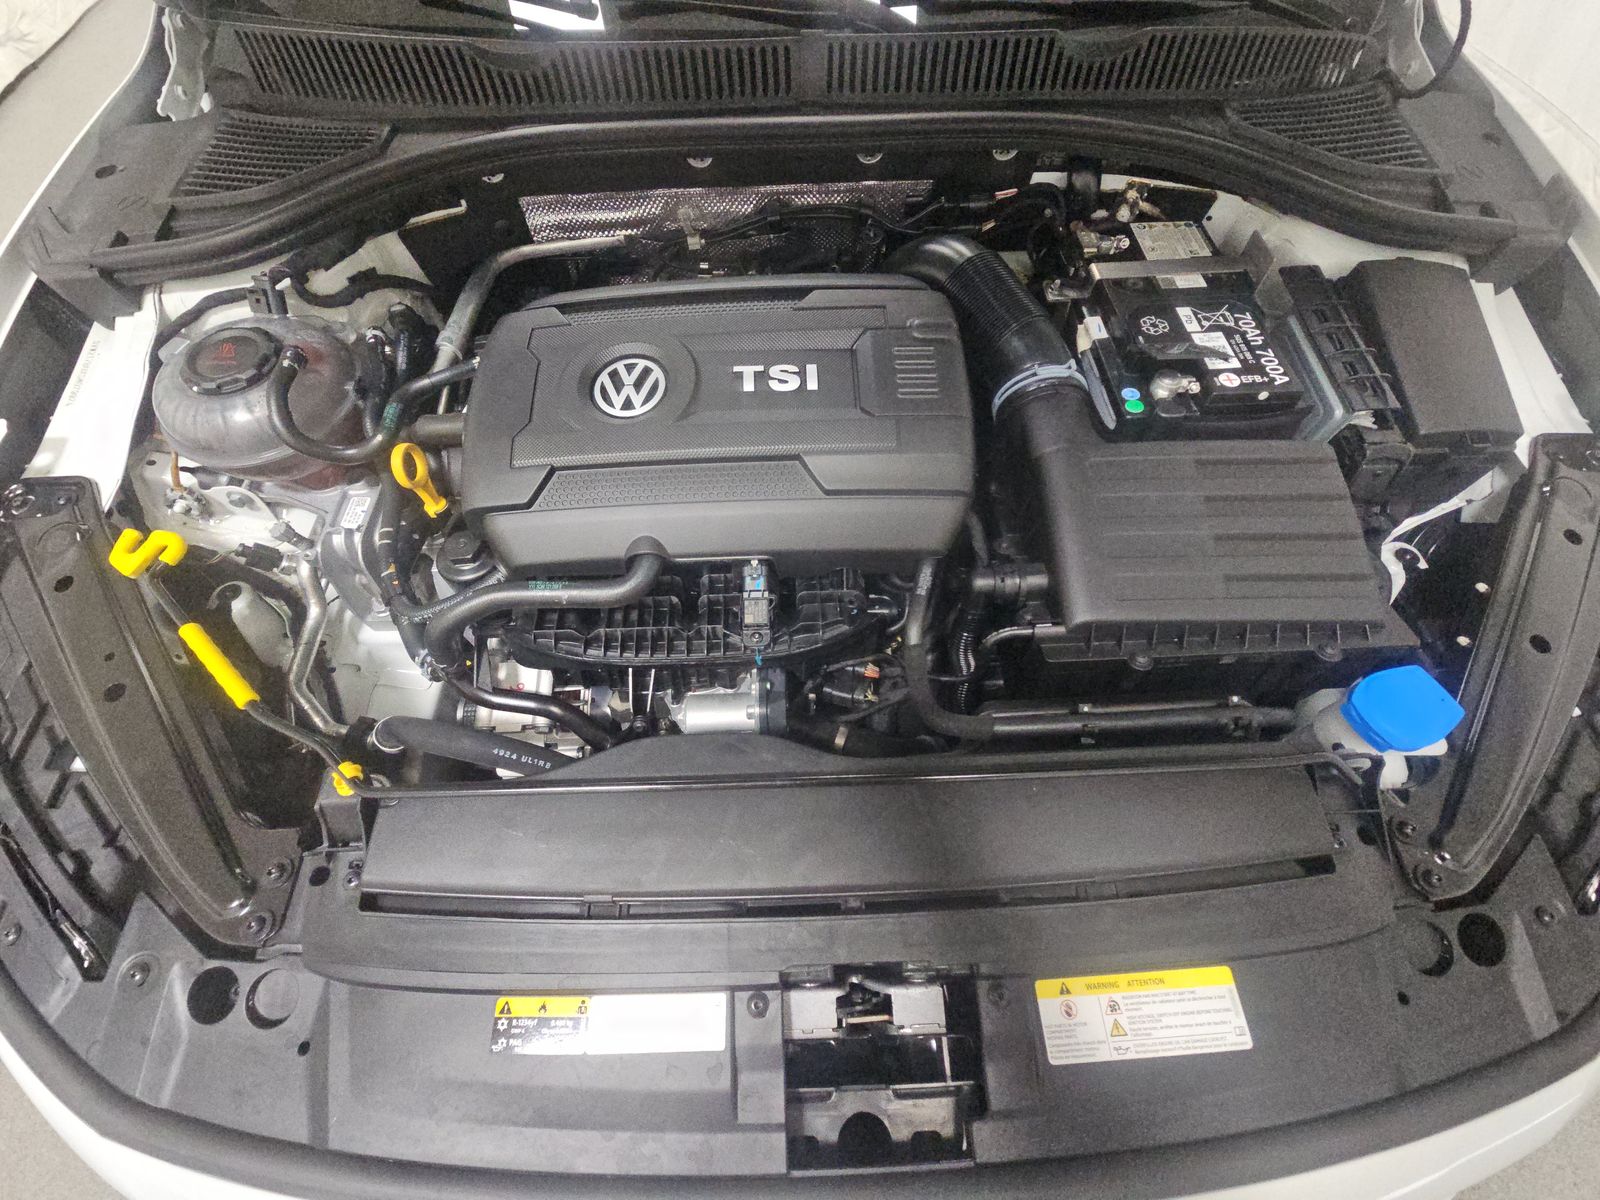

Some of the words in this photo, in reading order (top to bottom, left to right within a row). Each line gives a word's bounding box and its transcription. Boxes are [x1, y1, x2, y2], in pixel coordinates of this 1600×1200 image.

[1233, 311, 1265, 346] 70Ah
[1255, 348, 1290, 386] 700A
[732, 363, 819, 392] TSI
[493, 748, 517, 760] 4924
[1084, 980, 1120, 991] WARNING
[1127, 977, 1165, 987] ATTENTION
[512, 1018, 539, 1028] R-1234yf
